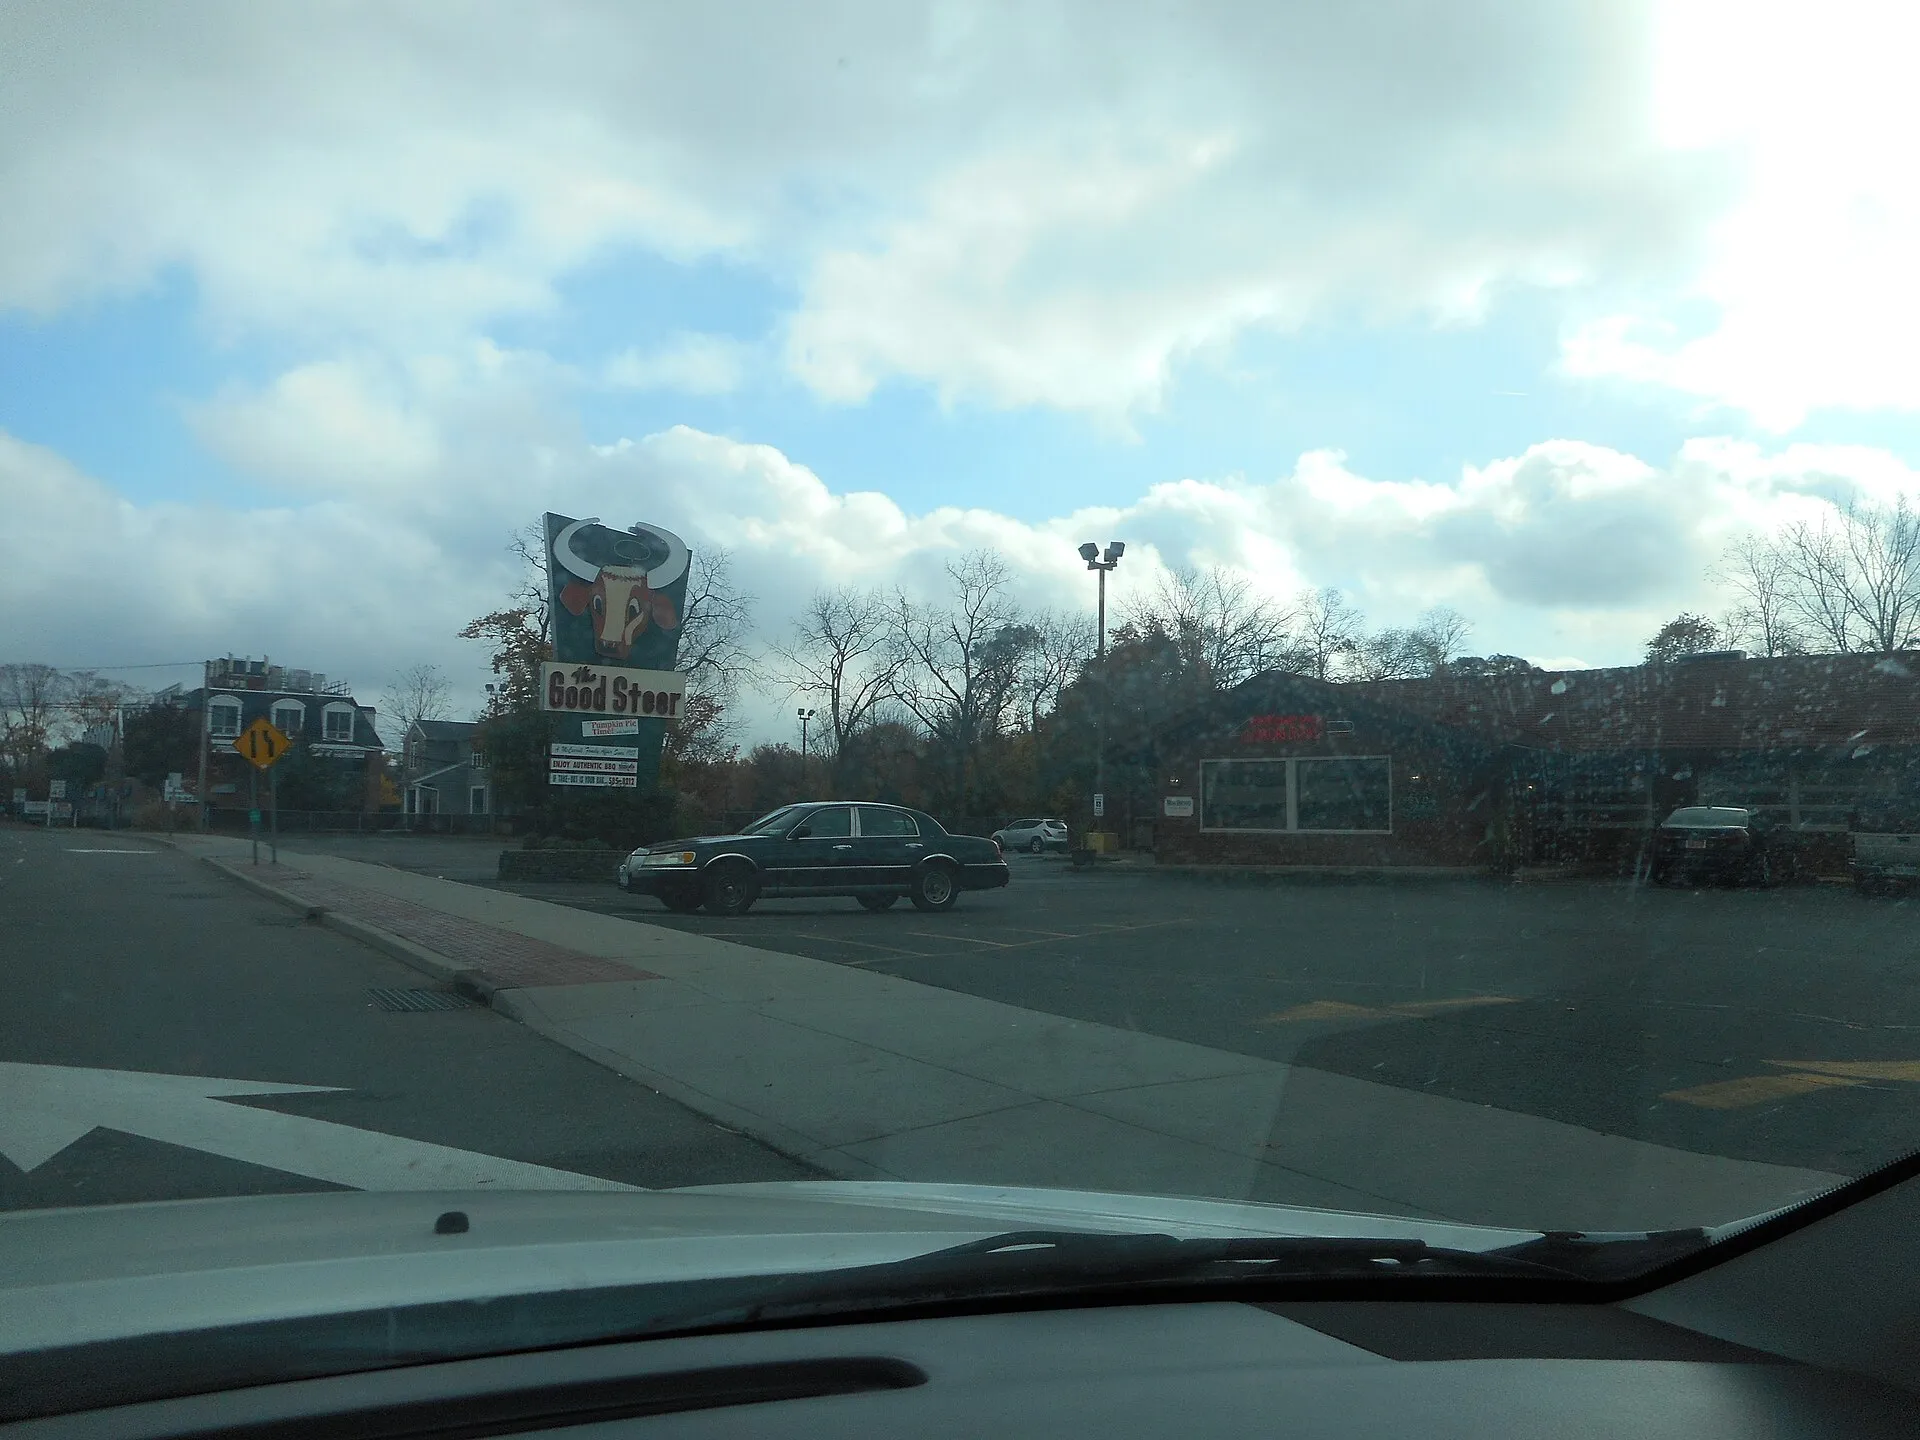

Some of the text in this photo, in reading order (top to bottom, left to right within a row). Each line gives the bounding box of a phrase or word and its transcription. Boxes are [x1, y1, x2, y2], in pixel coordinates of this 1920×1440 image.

[571, 666, 597, 685] The
[549, 671, 682, 716] Good Steer
[592, 719, 637, 729] Pumpkin Pie
[553, 760, 616, 771] ENJOY AUTHENTIC BBQ
